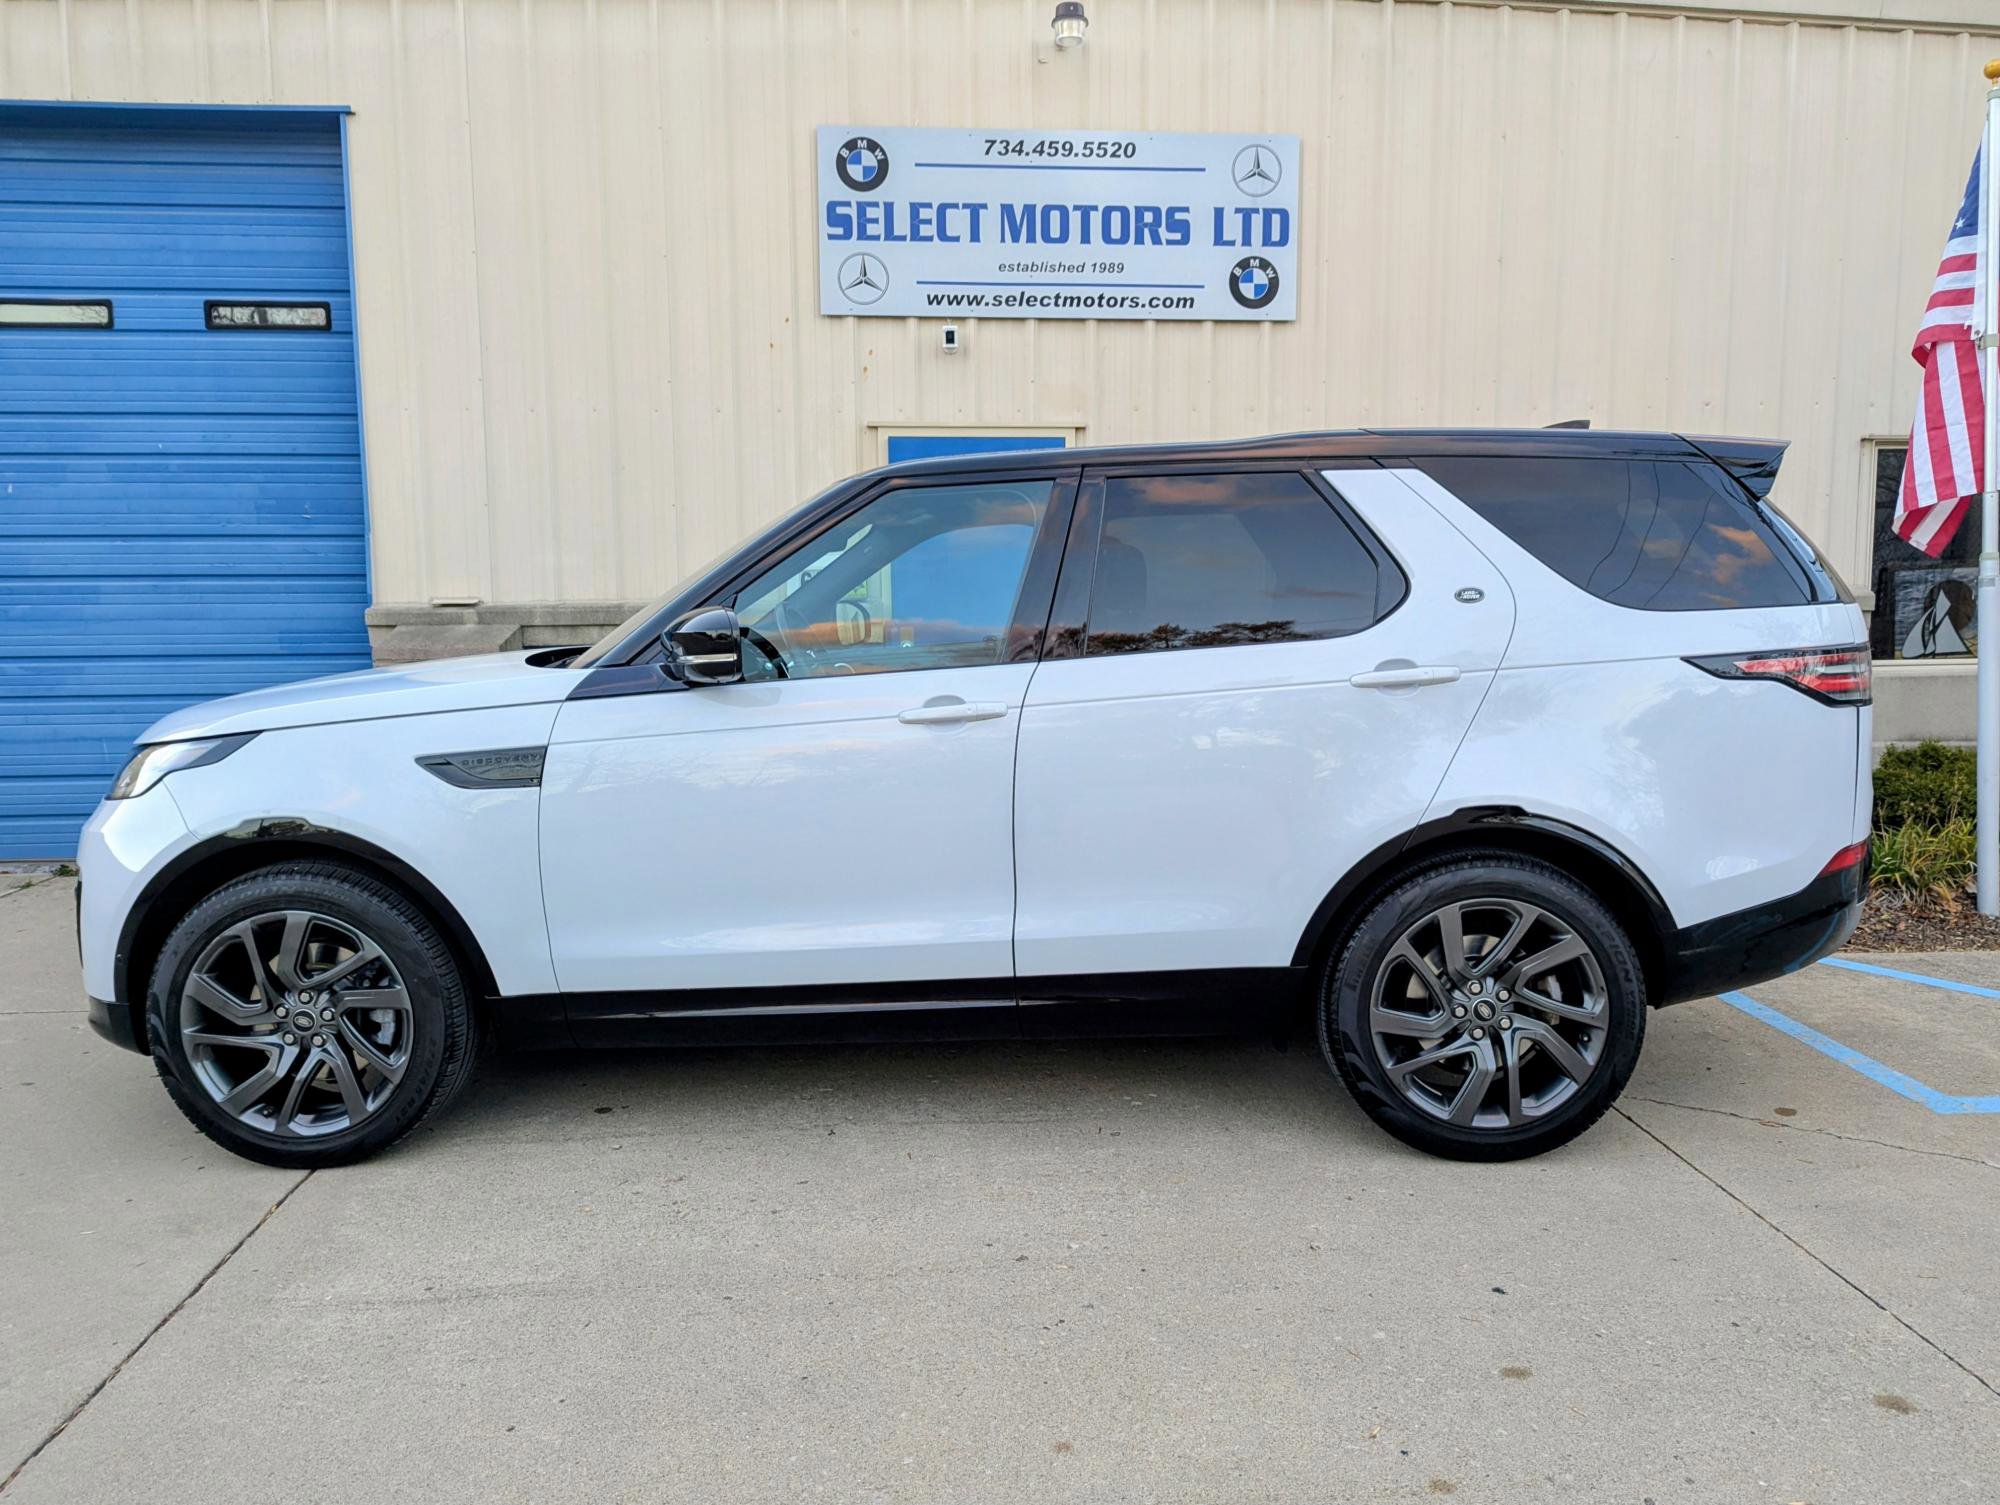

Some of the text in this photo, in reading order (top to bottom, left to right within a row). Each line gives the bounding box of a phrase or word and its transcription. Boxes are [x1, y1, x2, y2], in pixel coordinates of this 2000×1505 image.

[984, 139, 1137, 159] 734.459.5520
[826, 200, 1290, 248] SELECT MOTORS LTD
[998, 261, 1125, 275] established 1989
[926, 291, 1195, 309] www.selectmotors.com
